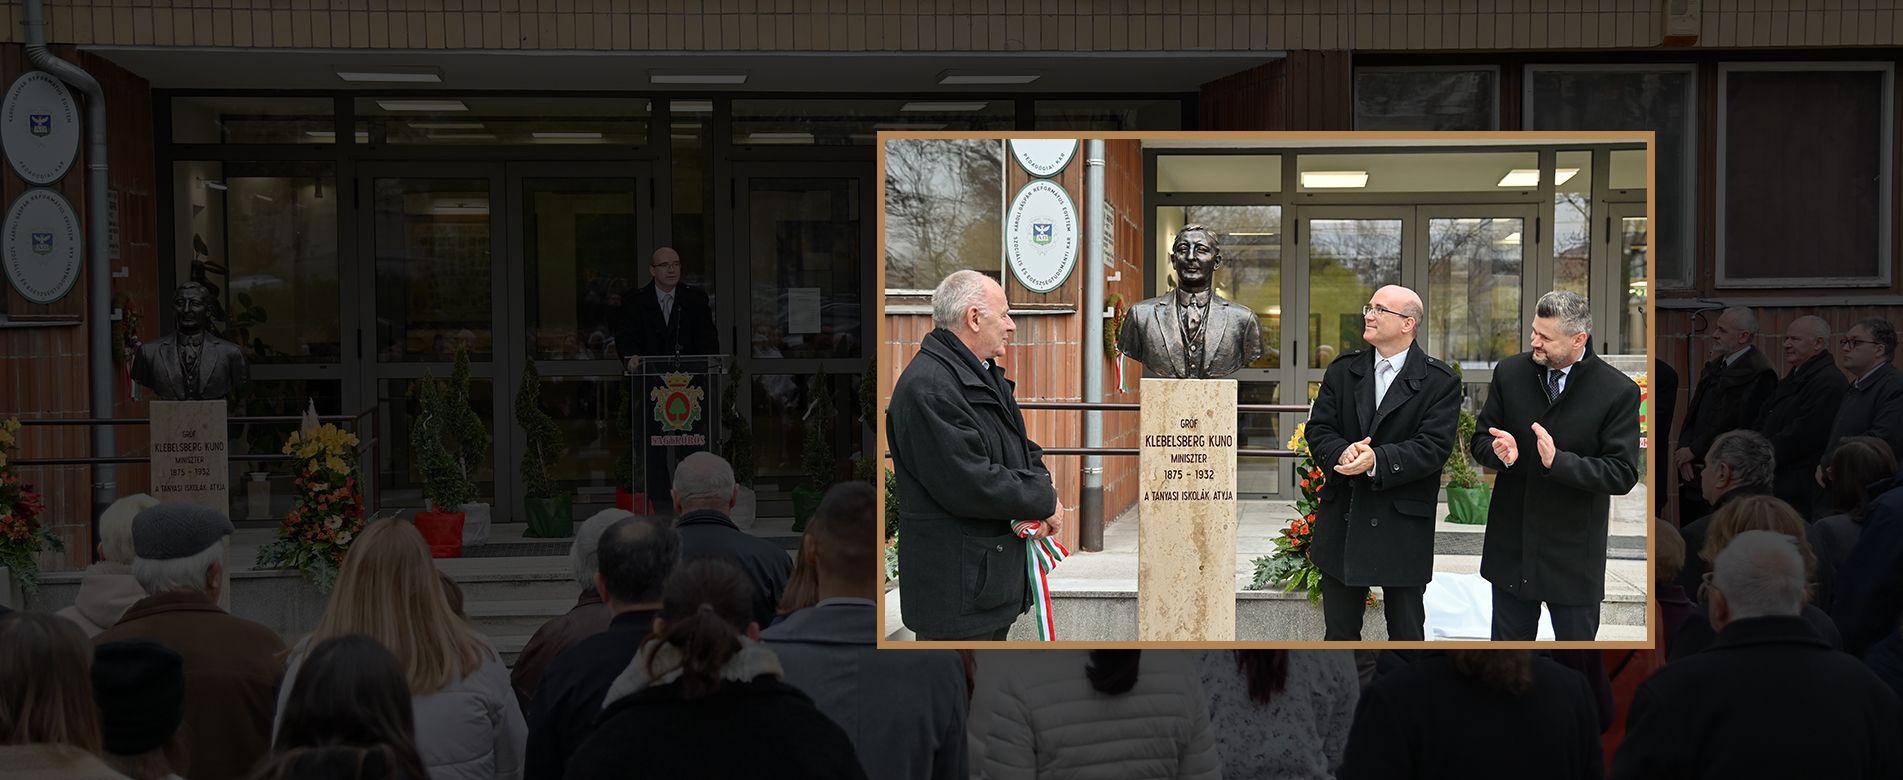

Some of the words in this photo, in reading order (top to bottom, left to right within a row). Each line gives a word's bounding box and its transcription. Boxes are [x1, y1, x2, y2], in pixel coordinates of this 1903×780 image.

[13, 81, 27, 100] GÁSPÁR
[28, 75, 62, 96] REFORMÁTUS
[62, 98, 72, 123] EGYETEM
[1023, 152, 1055, 171] PEDAGÓGIAI
[1055, 152, 1065, 164] KAR
[19, 160, 54, 179] PEDAGÓGIAI
[55, 160, 64, 172] KAR
[1019, 192, 1032, 212] GÁSPÁR
[1033, 186, 1065, 206] REFORMÁTUS
[1062, 207, 1071, 232] EGYETEM
[16, 200, 30, 220] GÁSPÁR
[31, 194, 65, 214] REFORMÁTUS
[64, 216, 74, 241] EGYETEM
[10, 246, 22, 277] SZOCIÁLIS
[1014, 236, 1024, 267] SZOCIÁLIS
[1022, 267, 1028, 276] ÉS
[1180, 417, 1198, 428] GRÓF
[154, 442, 202, 452] KLEBELSBERG
[205, 442, 224, 451] KUNO
[651, 434, 705, 446] NAGYKŐRÖS
[1146, 435, 1205, 447] KLEBELSBERG
[1209, 435, 1232, 447] KUNO
[1170, 454, 1207, 463] MINISZTER
[1164, 470, 1182, 479] 1875
[1195, 470, 1214, 479] 1932
[1144, 492, 1149, 500] A
[1152, 491, 1179, 500] TANYASI
[1182, 488, 1210, 500] ISKOLÁK
[1213, 491, 1233, 500] ATYJA
